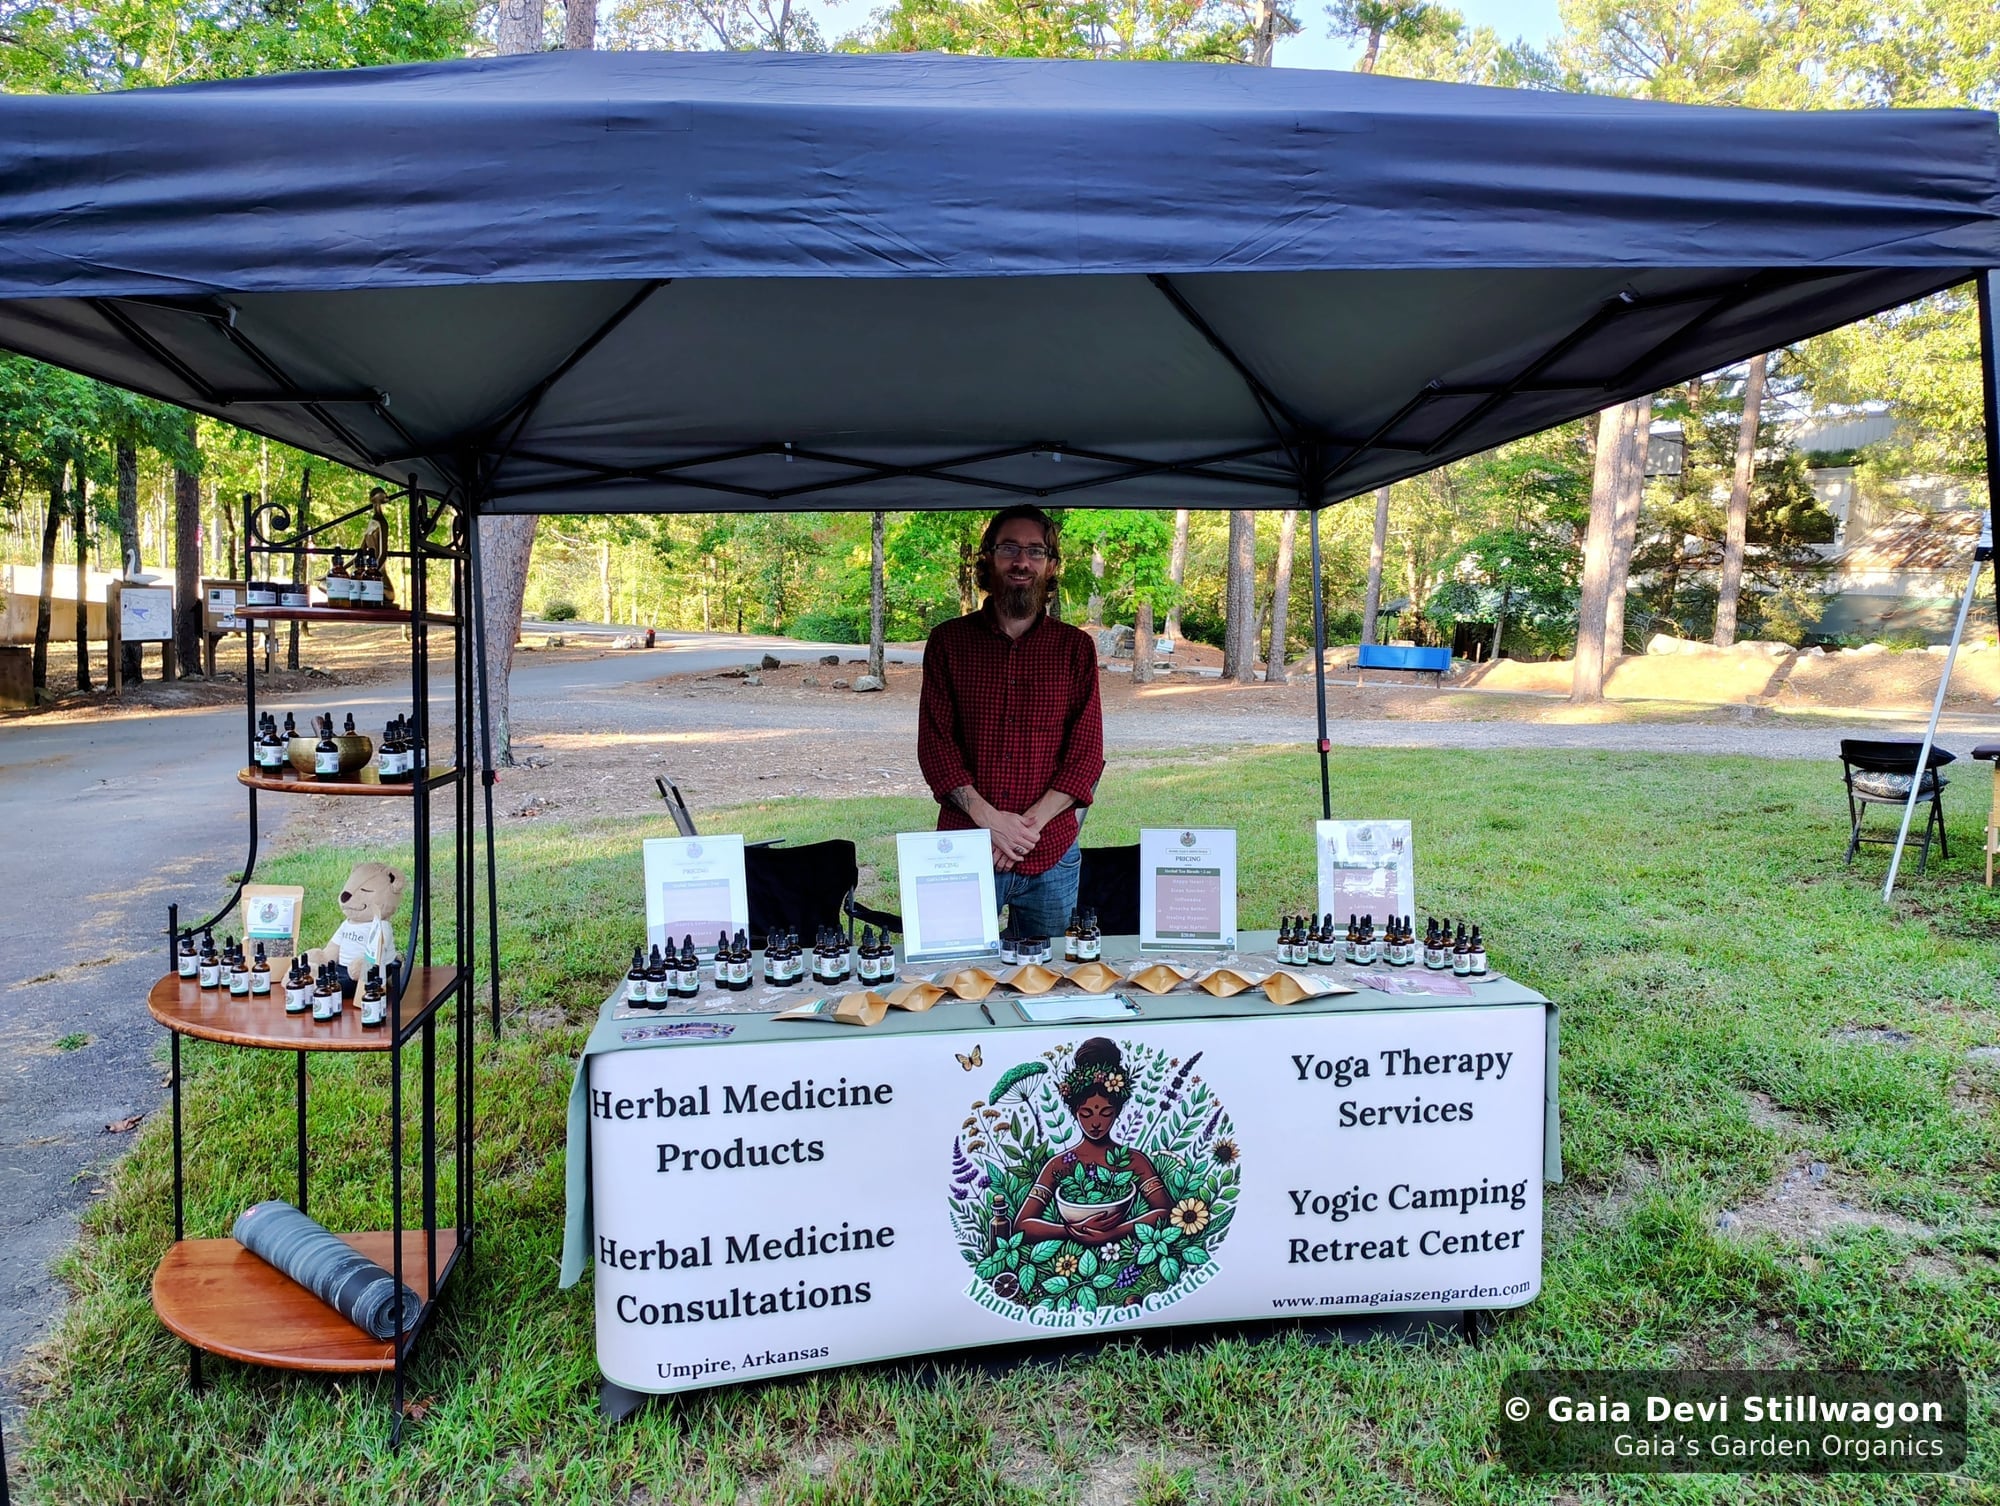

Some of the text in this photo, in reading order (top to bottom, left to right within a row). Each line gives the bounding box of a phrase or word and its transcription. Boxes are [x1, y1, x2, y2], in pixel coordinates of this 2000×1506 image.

[1291, 1047, 1514, 1088] Yoga Therapy
[591, 1077, 893, 1121] Herbal Medicine
[1339, 1096, 1474, 1128] Services
[656, 1137, 825, 1173] Products
[1287, 1177, 1528, 1223] Yogic Camping
[599, 1221, 895, 1271] Herbal Medicine
[1287, 1229, 1525, 1264] Retreat Center
[616, 1280, 872, 1326] Consultations
[964, 1278, 1025, 1324] Mama
[1098, 1302, 1142, 1326] Zen
[1144, 1260, 1222, 1314] Garden
[1271, 1281, 1530, 1309] www.mamagaiaszengarden.com
[656, 1345, 829, 1381] Umpire, Arkansas
